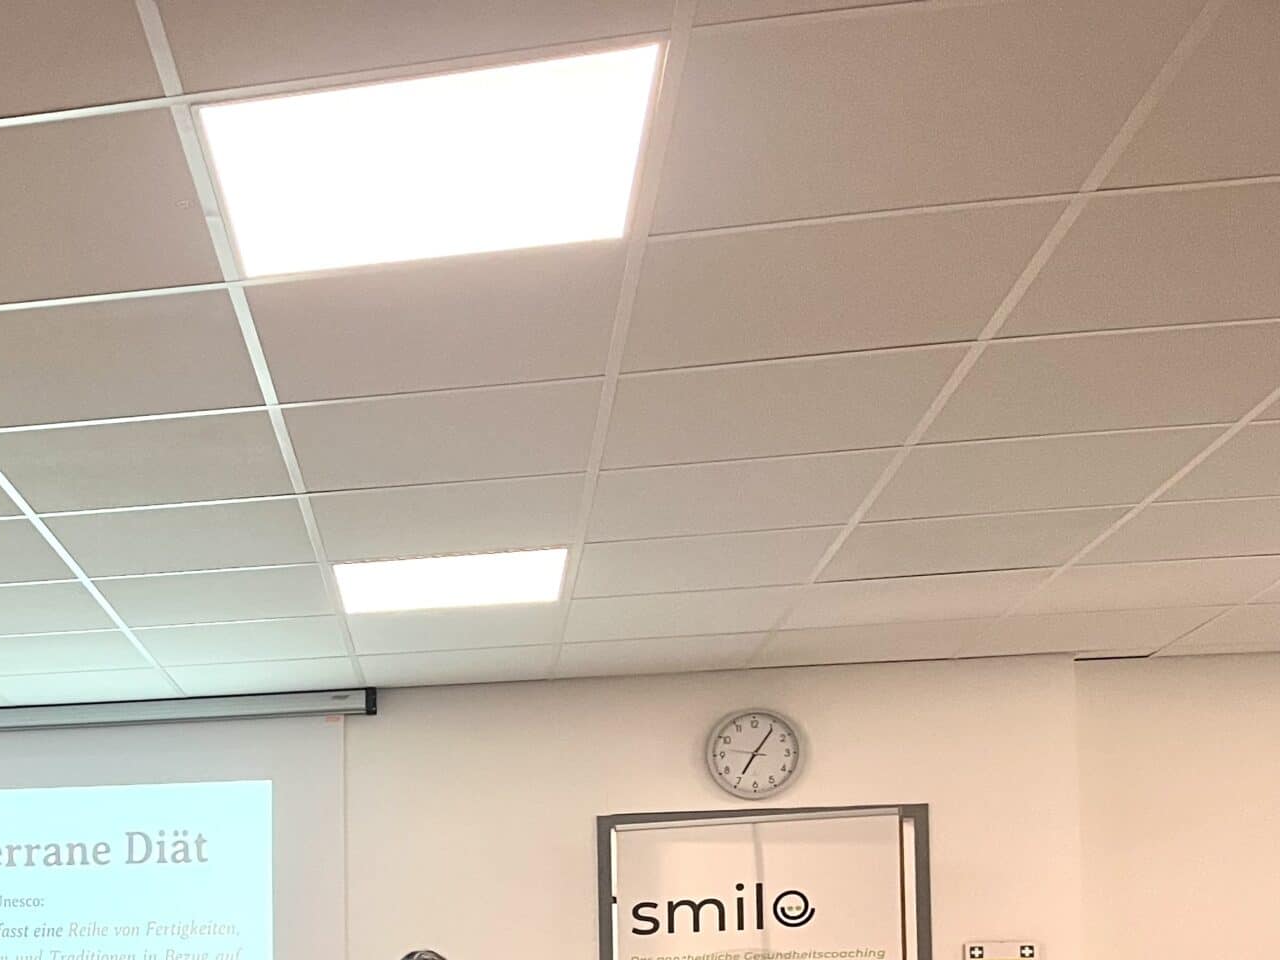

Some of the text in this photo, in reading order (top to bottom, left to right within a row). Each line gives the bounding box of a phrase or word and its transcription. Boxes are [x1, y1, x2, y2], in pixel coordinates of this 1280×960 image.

[124, 829, 209, 865] Diät
[33, 922, 64, 938] eine
[67, 921, 109, 938] Reihe
[114, 926, 140, 937] von
[146, 919, 240, 941] Fertigkeiten,
[744, 947, 886, 960] Gesundheitscoaching
